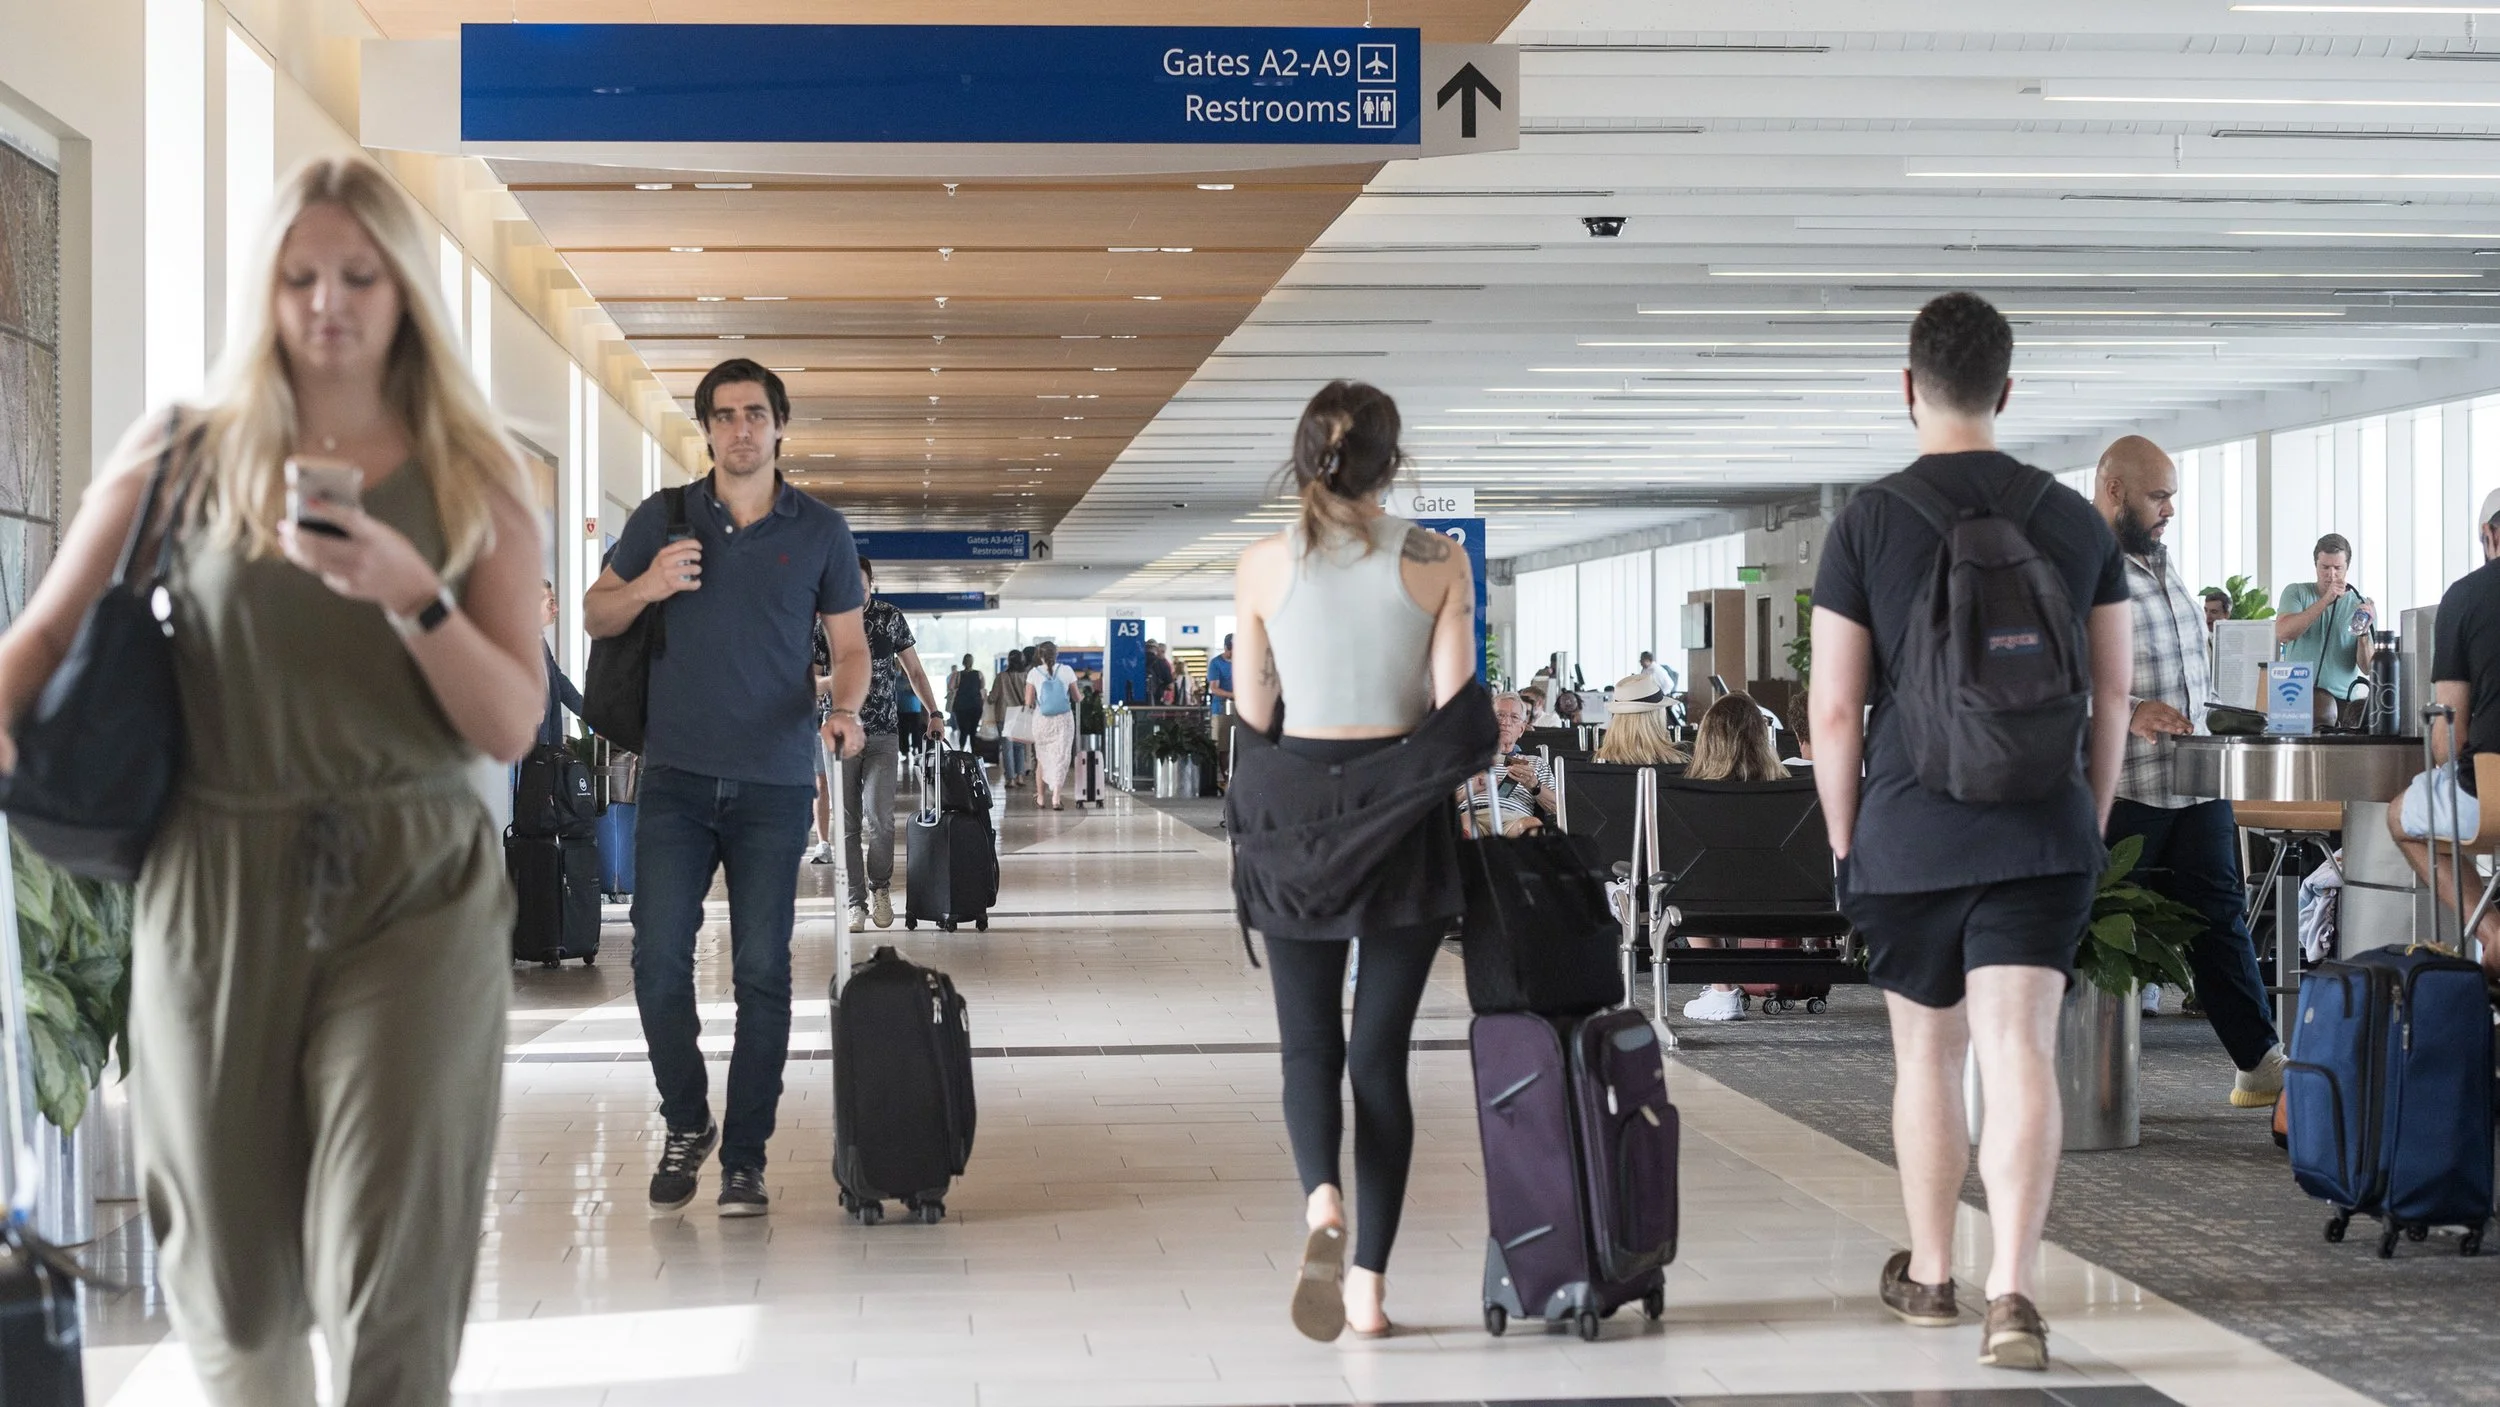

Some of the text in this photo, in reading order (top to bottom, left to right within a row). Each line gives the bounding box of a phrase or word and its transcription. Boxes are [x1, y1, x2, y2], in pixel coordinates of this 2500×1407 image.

[1162, 47, 1351, 77] Gates A2-A9
[1185, 94, 1351, 123] Restrooms
[1412, 495, 1456, 513] Gate
[967, 535, 1013, 545] Gates A3-A9
[972, 546, 1013, 555] Restrooms
[1118, 622, 1139, 636] A3
[2273, 669, 2289, 677] FREE
